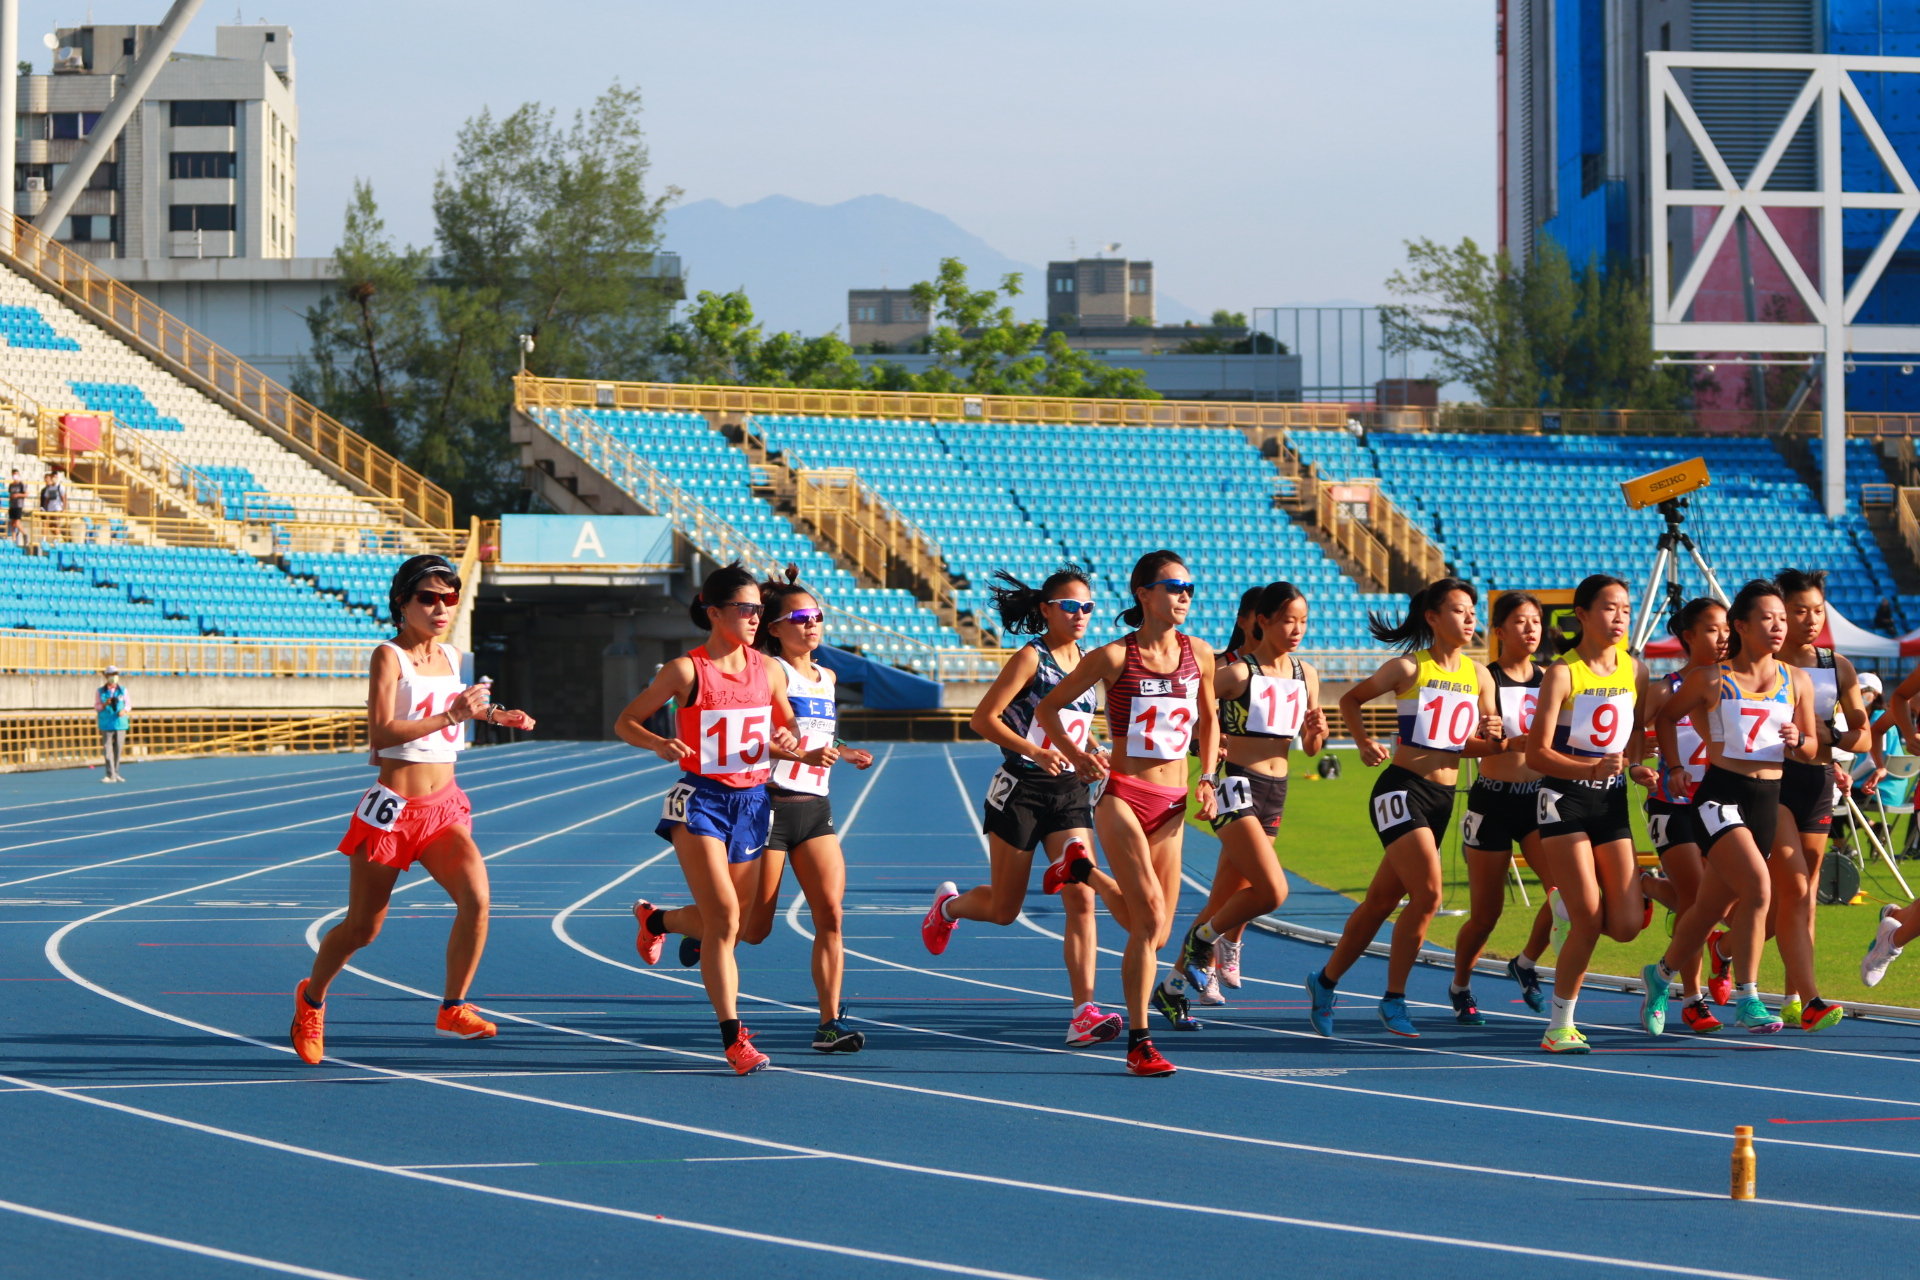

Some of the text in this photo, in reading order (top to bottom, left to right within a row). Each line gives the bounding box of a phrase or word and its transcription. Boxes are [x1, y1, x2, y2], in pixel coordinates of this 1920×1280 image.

[1650, 473, 1686, 492] SEIKO
[572, 521, 605, 558] A
[1142, 680, 1169, 693] 仁武
[809, 700, 834, 717] 仁武
[1260, 684, 1299, 729] 11
[1424, 696, 1474, 745] 10
[707, 715, 765, 765] 15
[1136, 706, 1190, 752] 13
[1590, 704, 1618, 747] 9
[1741, 708, 1770, 753] 7
[991, 772, 1013, 807] 12
[1218, 781, 1246, 808] 11
[1477, 775, 1542, 794] PRO NIKE
[364, 790, 398, 824] 16
[667, 787, 691, 818] 15
[1378, 795, 1404, 825] 10
[1540, 793, 1548, 820] 9
[1464, 817, 1472, 840] 6
[1652, 818, 1660, 843] 4
